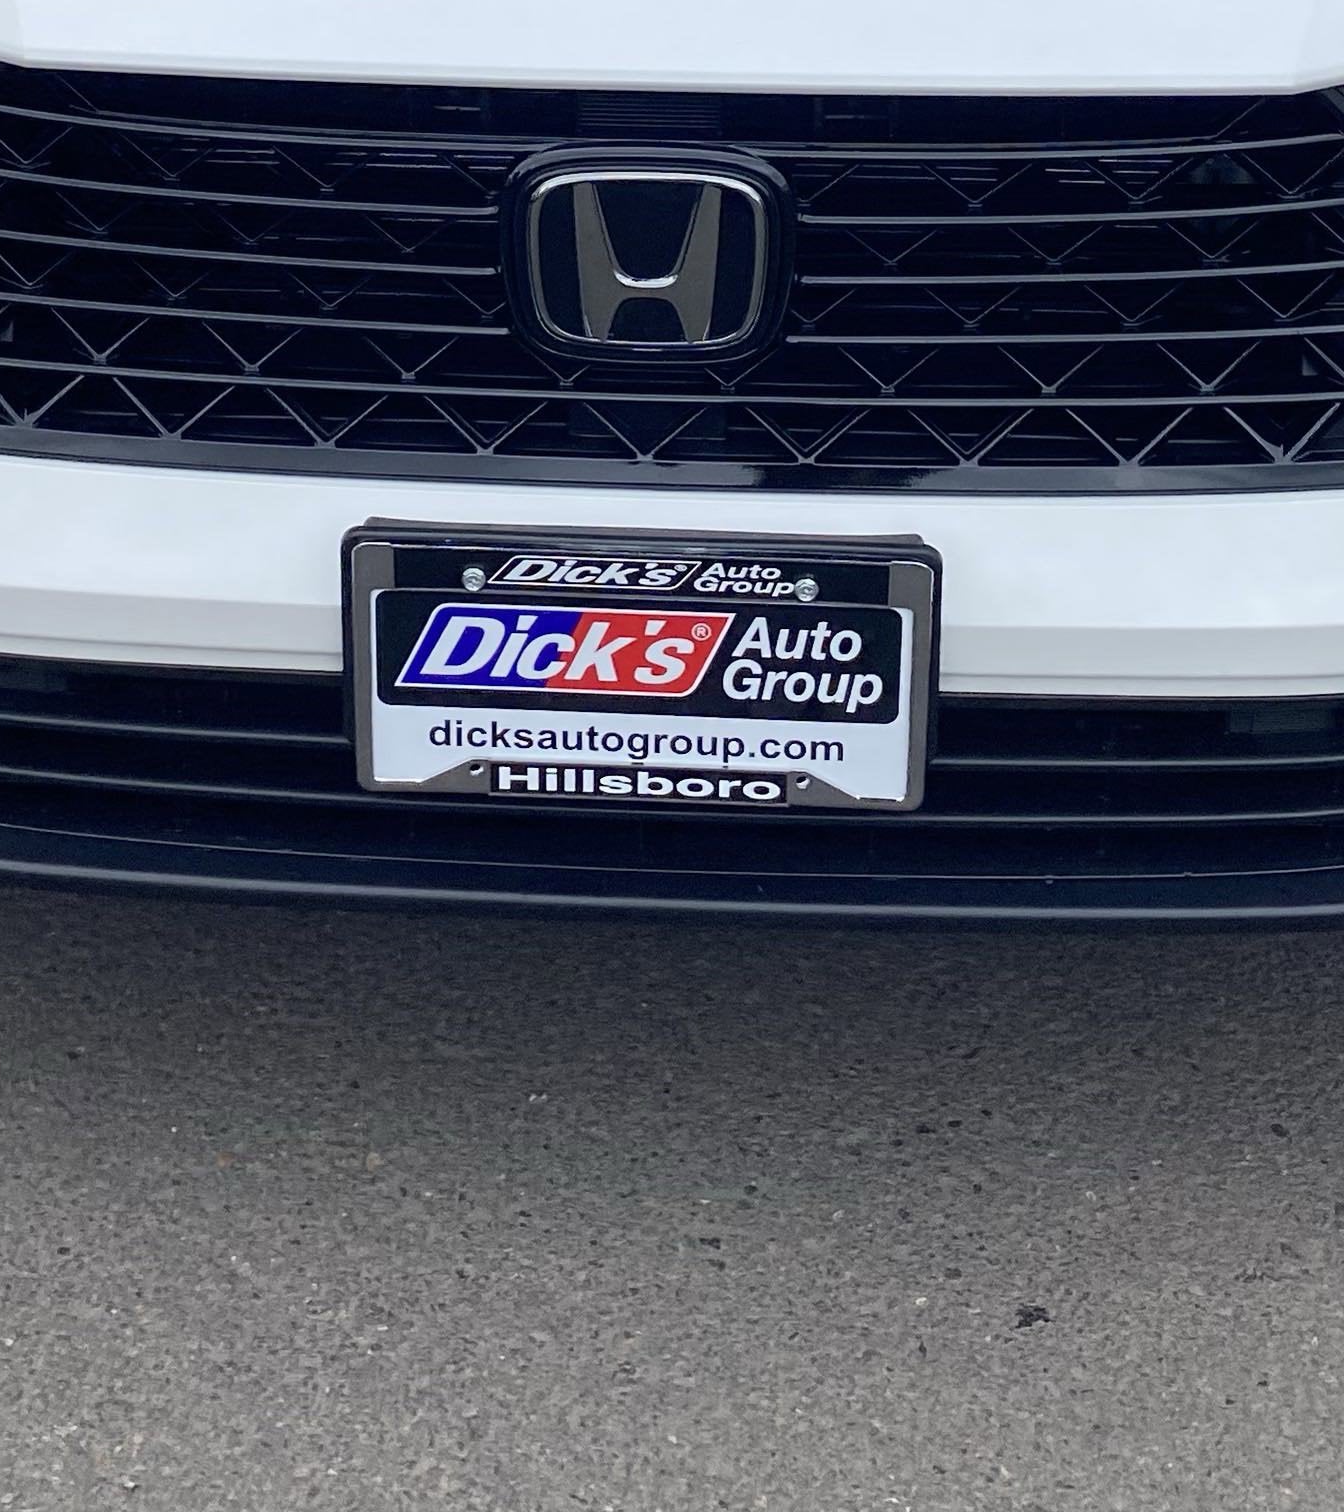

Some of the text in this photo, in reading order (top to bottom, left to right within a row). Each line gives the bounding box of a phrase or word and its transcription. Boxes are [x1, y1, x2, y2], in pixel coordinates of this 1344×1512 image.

[693, 576, 794, 597] Group
[701, 562, 781, 579] Auto
[731, 616, 862, 662] Auto
[722, 658, 883, 713] Group
[429, 719, 844, 763] dicksautogroup.com
[498, 766, 782, 801] Hillsboro
